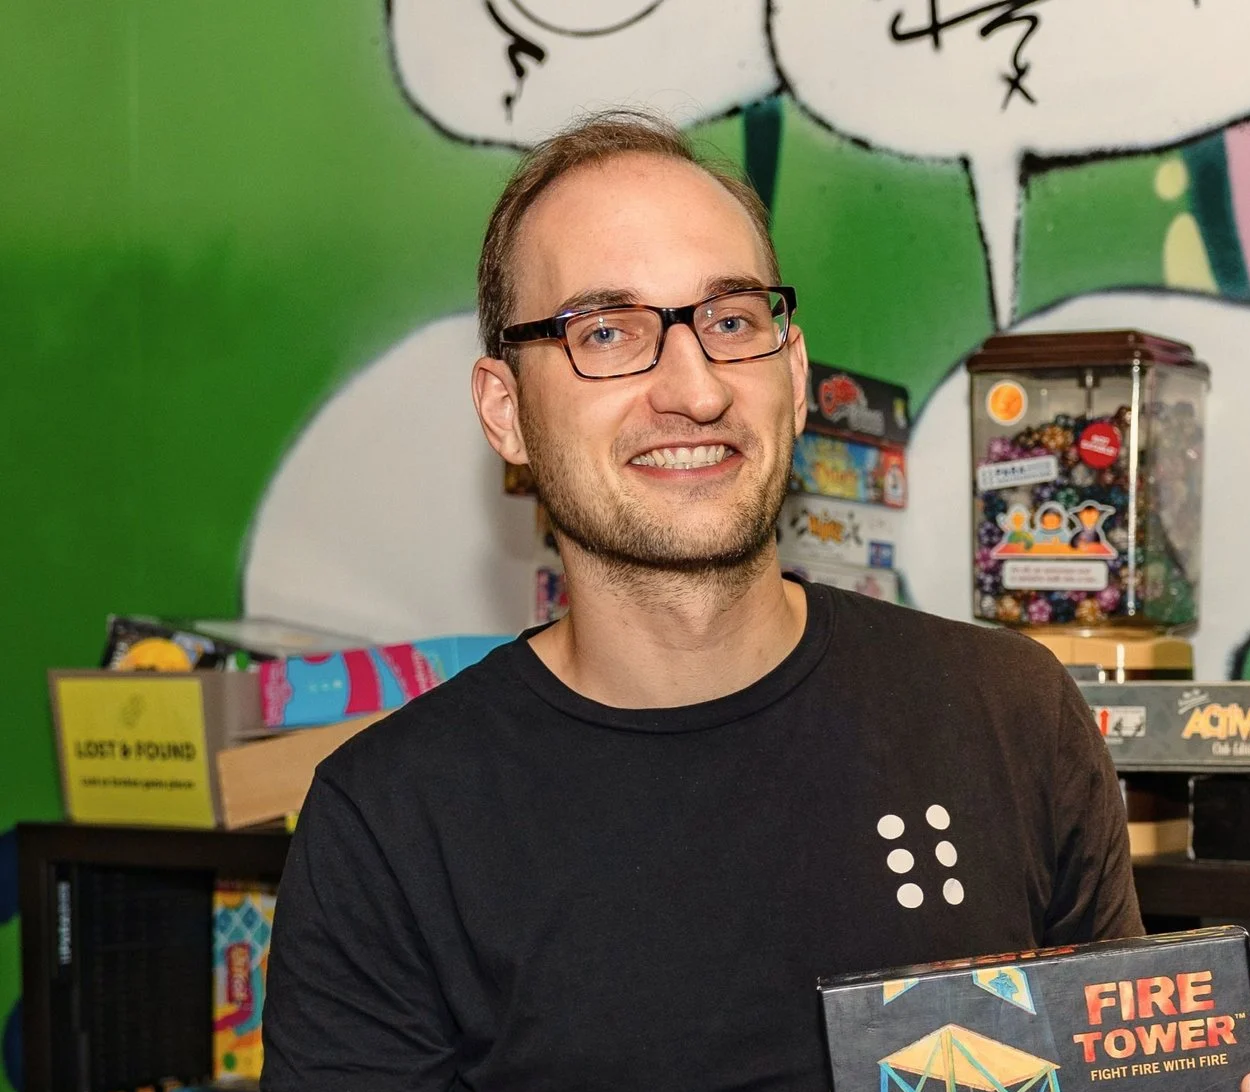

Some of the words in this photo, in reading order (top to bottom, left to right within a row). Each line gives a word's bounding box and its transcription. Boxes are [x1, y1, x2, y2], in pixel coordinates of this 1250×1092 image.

[75, 739, 115, 760] LOST
[134, 739, 197, 762] FOUND
[1084, 970, 1216, 1025] FIRE
[1091, 1066, 1128, 1081] FIGHT
[1132, 1062, 1161, 1077] FIRE
[1164, 1058, 1196, 1072] WITH
[1199, 1054, 1229, 1067] FIRE
